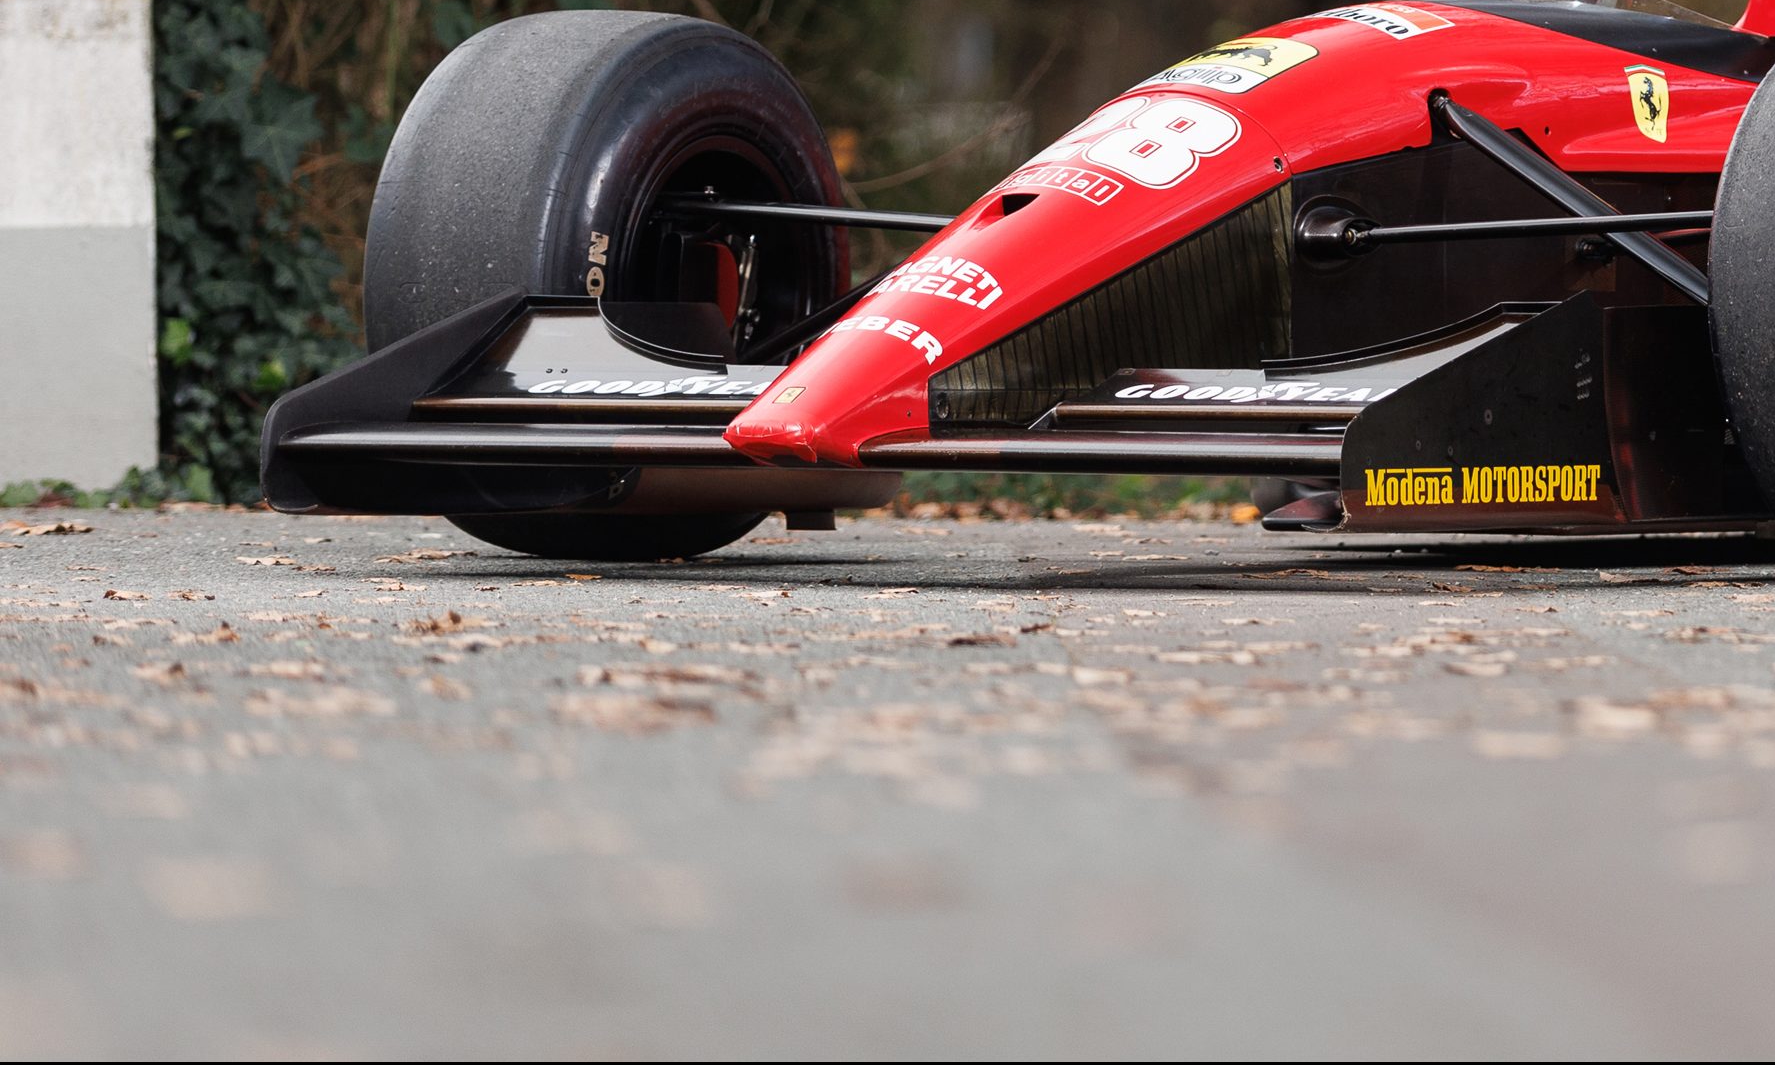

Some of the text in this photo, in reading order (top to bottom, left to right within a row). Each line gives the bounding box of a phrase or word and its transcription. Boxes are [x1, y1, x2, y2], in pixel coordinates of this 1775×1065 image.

[1013, 96, 1243, 189] 28
[995, 168, 1112, 199] igital
[864, 274, 1003, 310] ARELLI
[817, 316, 943, 365] EBER
[528, 376, 770, 397] GOODYEA
[1365, 464, 1600, 506] Modena MOTORSPORT
